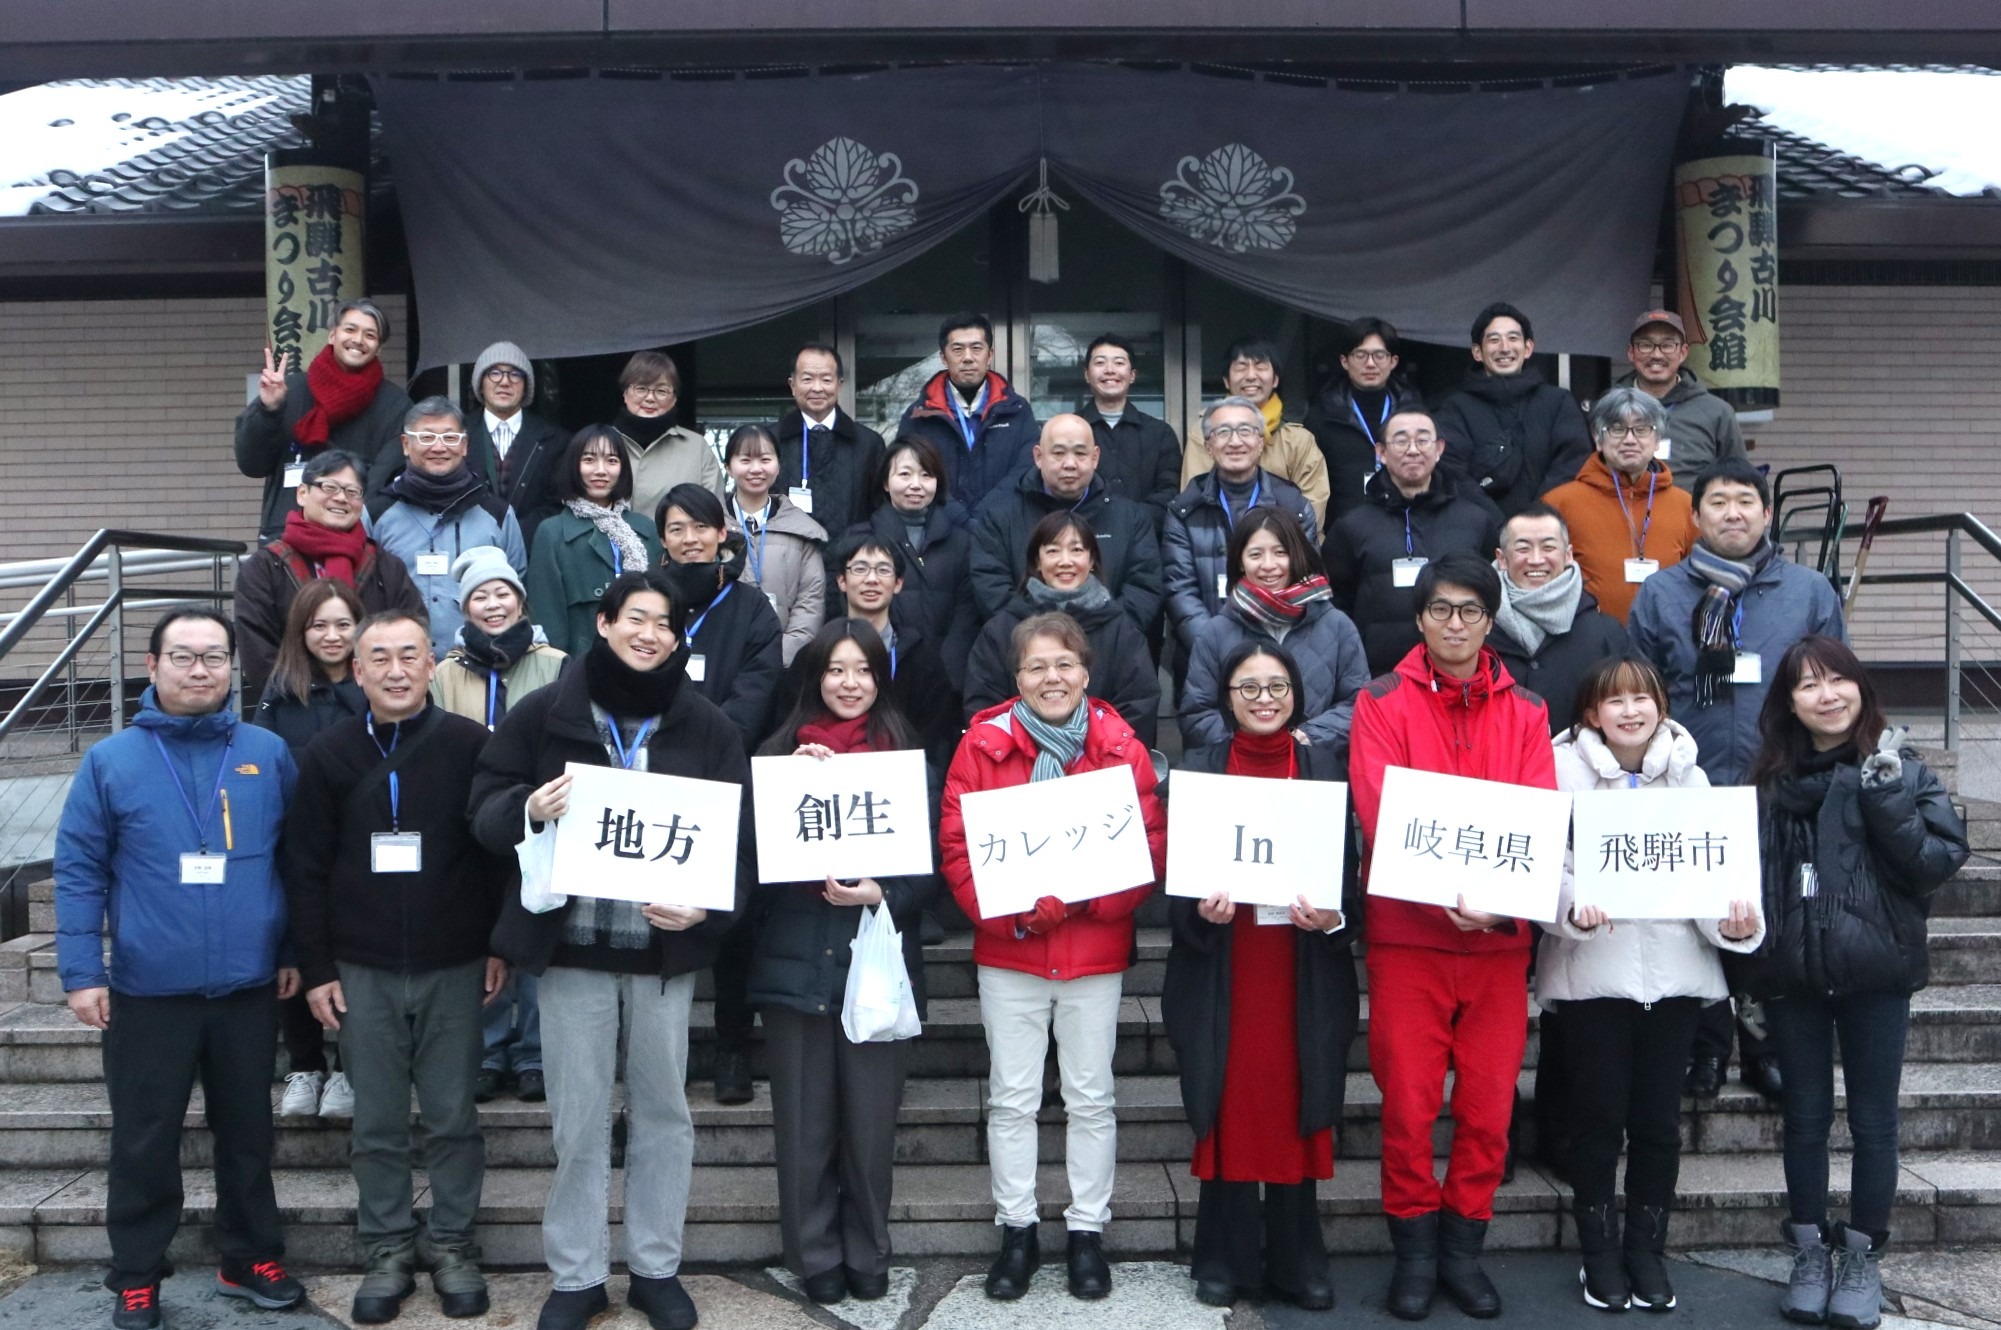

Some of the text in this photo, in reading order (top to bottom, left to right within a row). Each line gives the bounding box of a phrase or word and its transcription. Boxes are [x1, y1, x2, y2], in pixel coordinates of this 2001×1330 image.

[1707, 182, 1748, 372] まつり会館
[1748, 173, 1777, 323] 飛騨古川
[594, 806, 702, 866] 地方
[794, 791, 895, 843] 創生
[978, 803, 1135, 867] カレッジ
[1233, 824, 1275, 866] In
[1404, 817, 1535, 873] 岐阜県
[1599, 831, 1728, 873] 飛騨市
